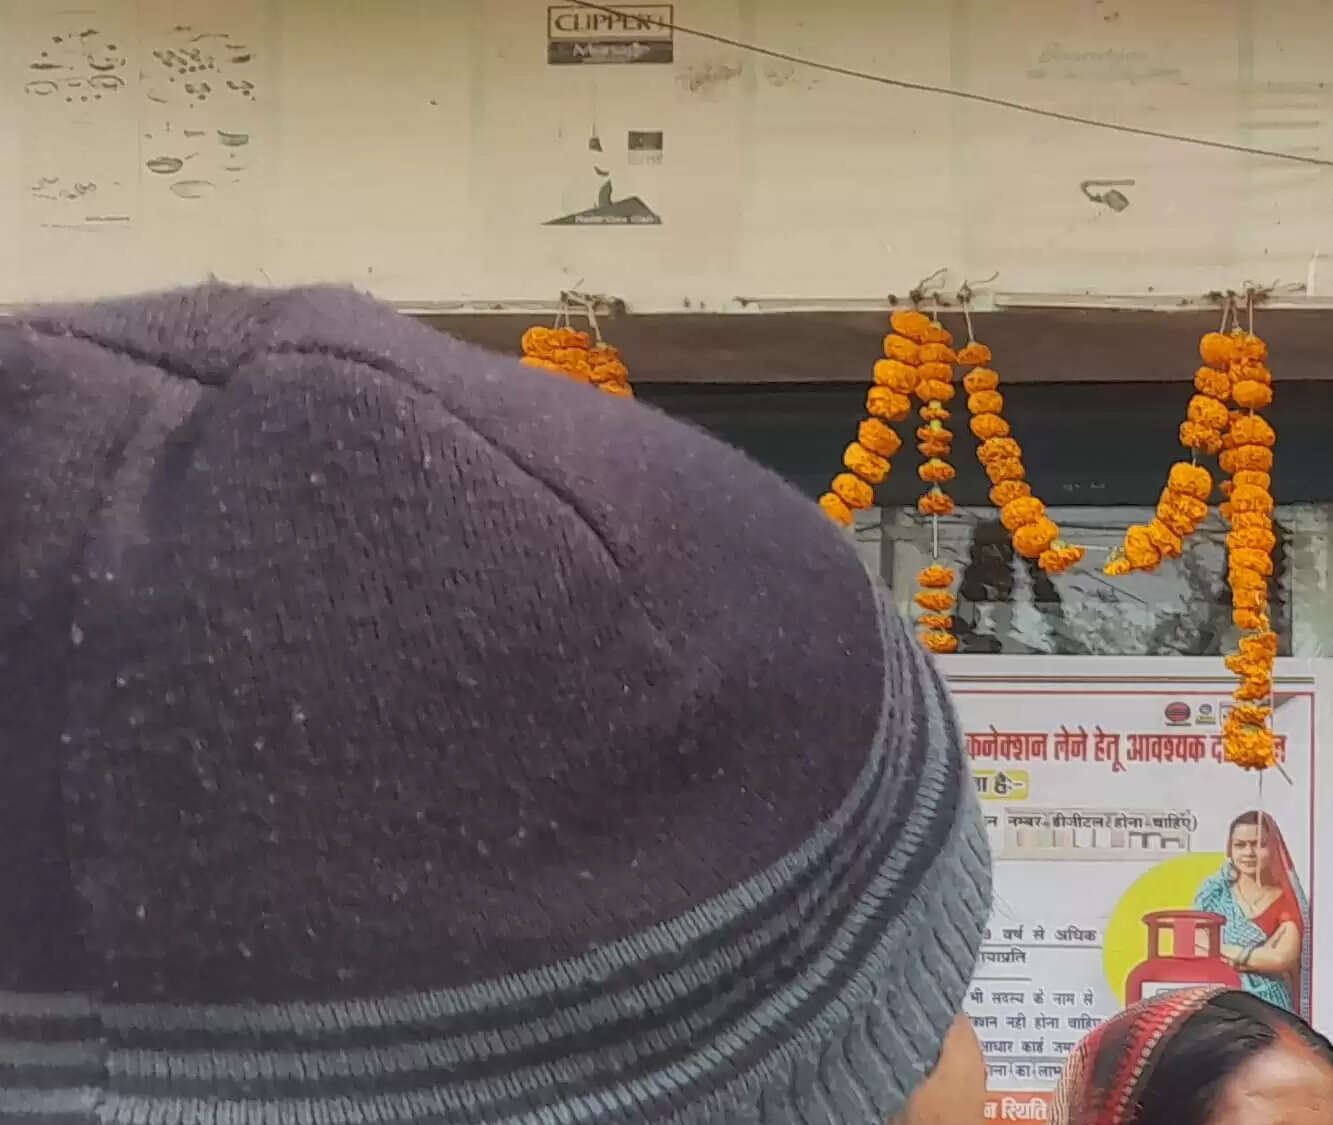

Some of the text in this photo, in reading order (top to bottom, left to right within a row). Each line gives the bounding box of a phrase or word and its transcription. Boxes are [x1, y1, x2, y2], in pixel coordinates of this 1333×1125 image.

[1054, 724, 1088, 761] लेने
[1127, 734, 1207, 763] आवश्यक
[1052, 992, 1075, 1006] नाम
[1034, 1012, 1060, 1030] होना
